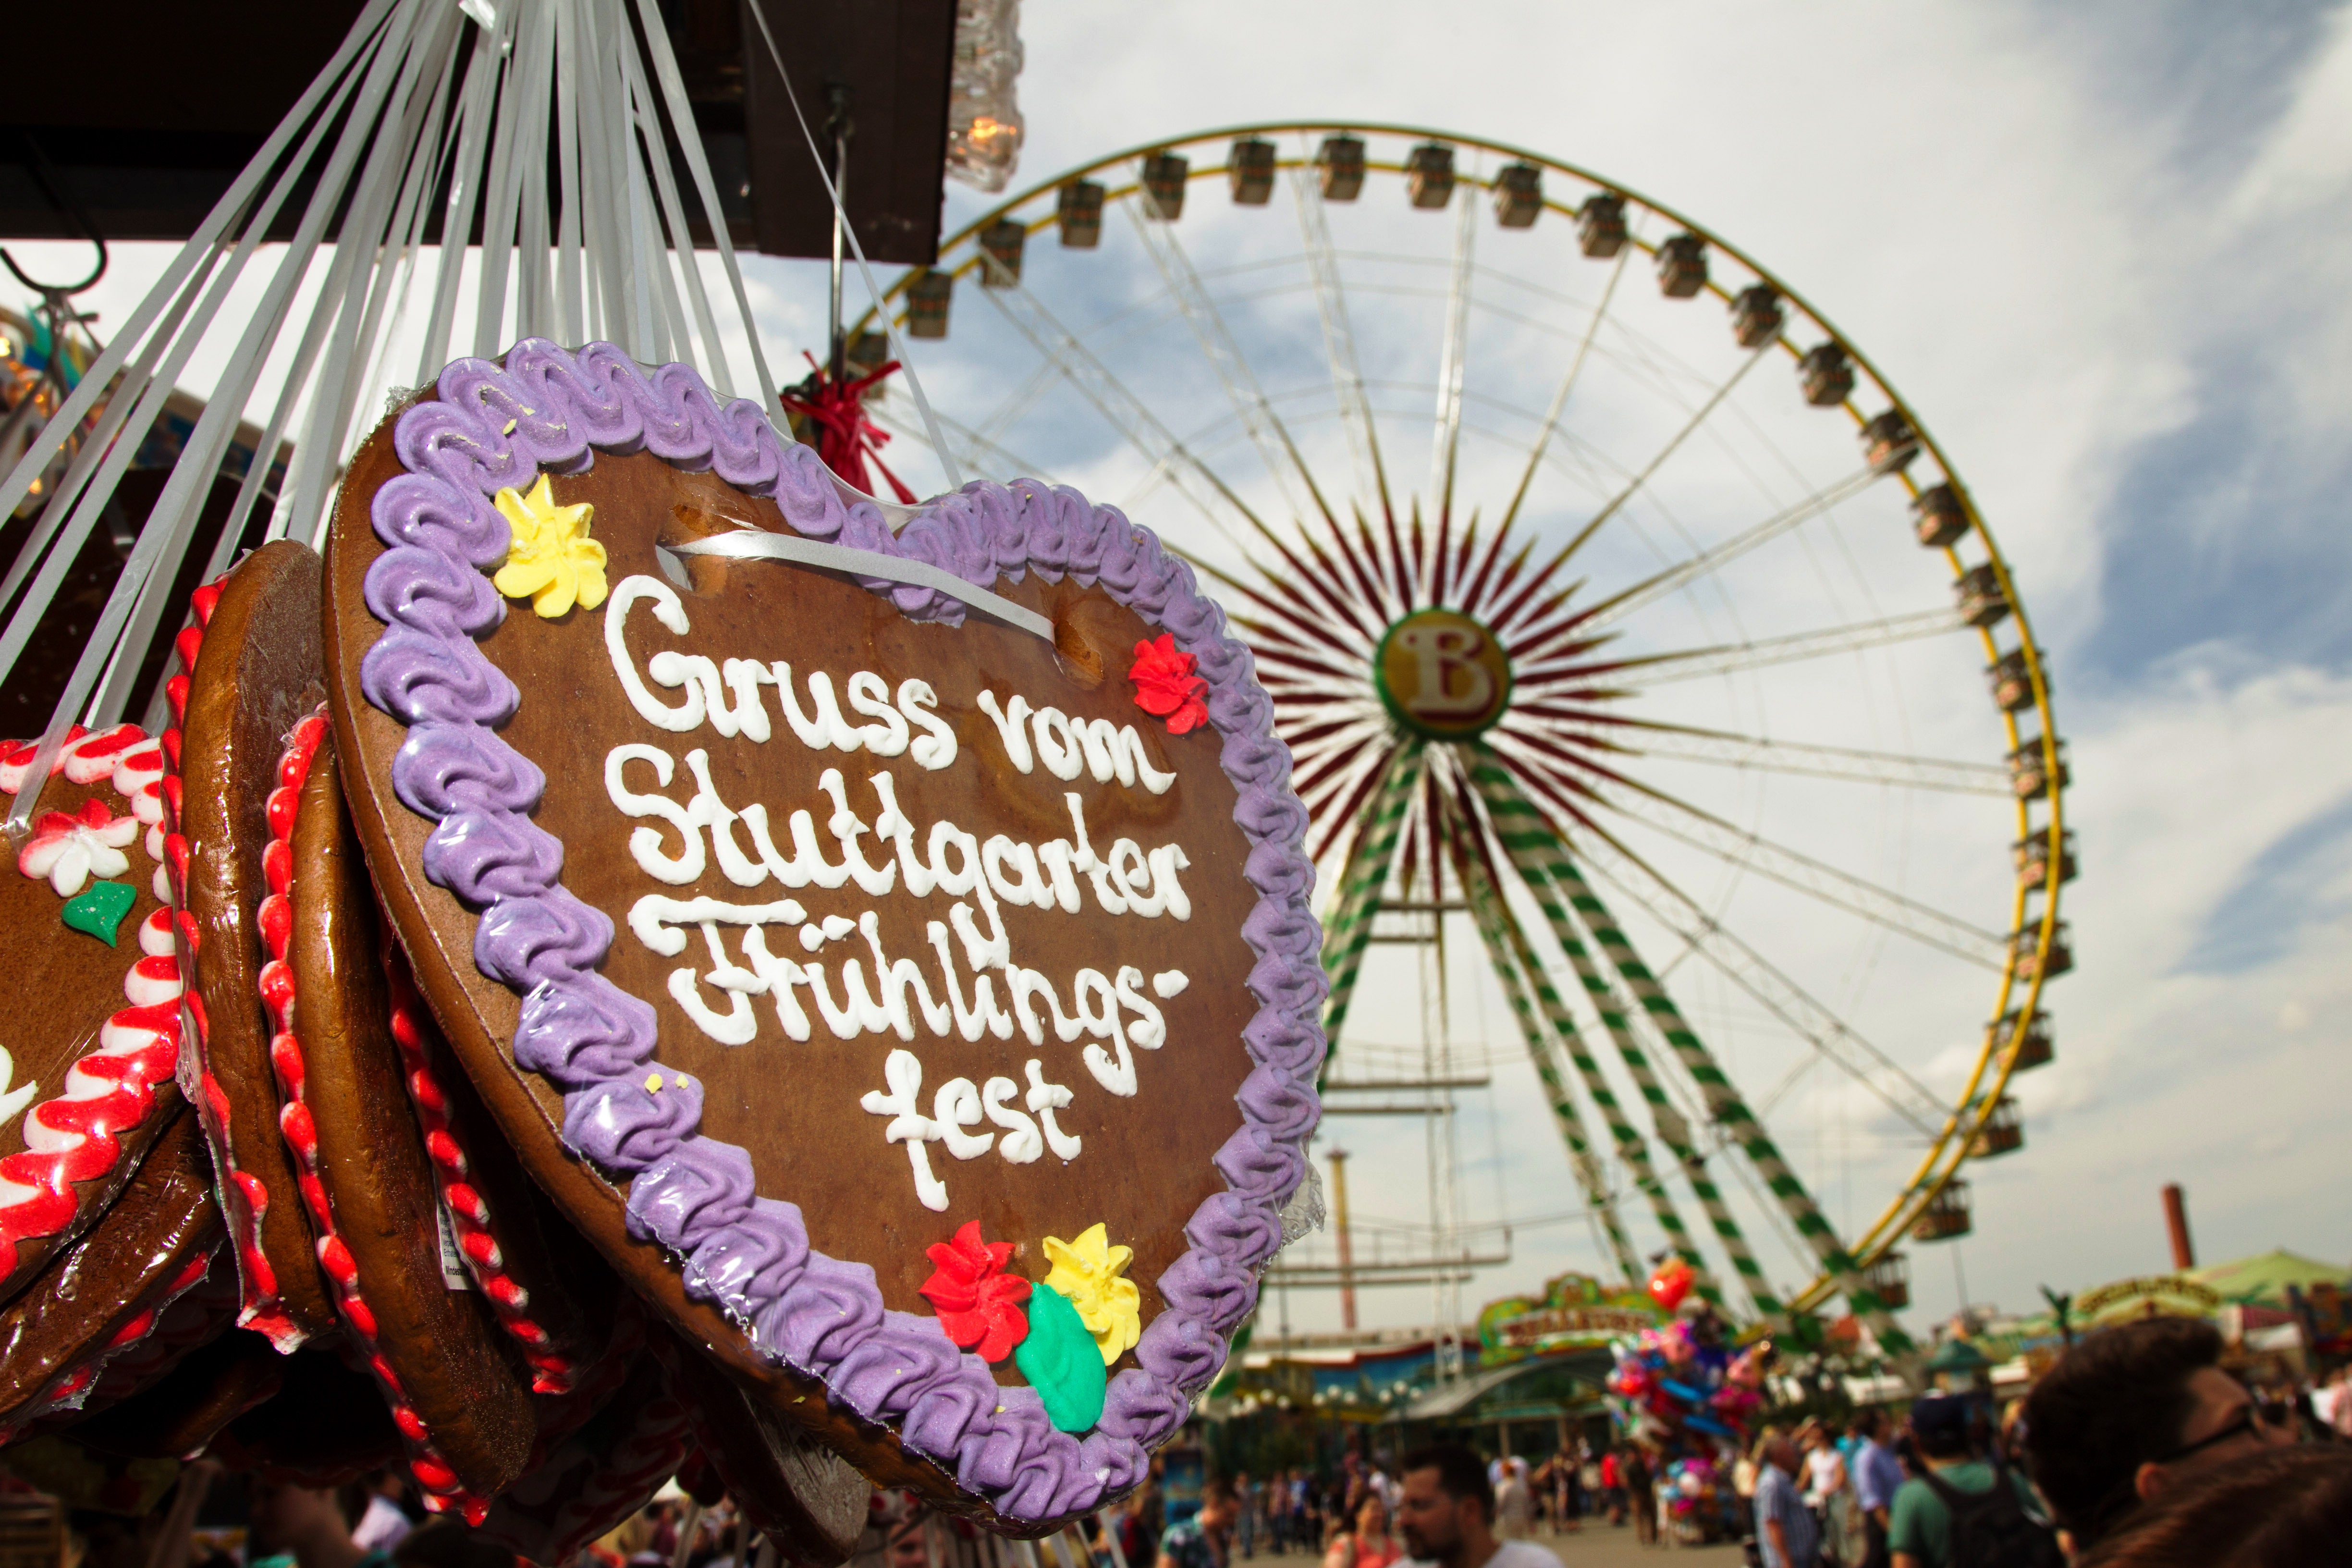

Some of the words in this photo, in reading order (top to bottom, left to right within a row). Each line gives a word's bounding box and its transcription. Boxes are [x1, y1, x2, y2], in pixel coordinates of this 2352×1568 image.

[605, 575, 957, 771] Gruss
[977, 689, 1176, 795] vom
[1396, 626, 1494, 717] B
[605, 743, 1191, 971] Stuttgarter
[628, 894, 1189, 1097] Frühlings-
[860, 1049, 1081, 1212] fest
